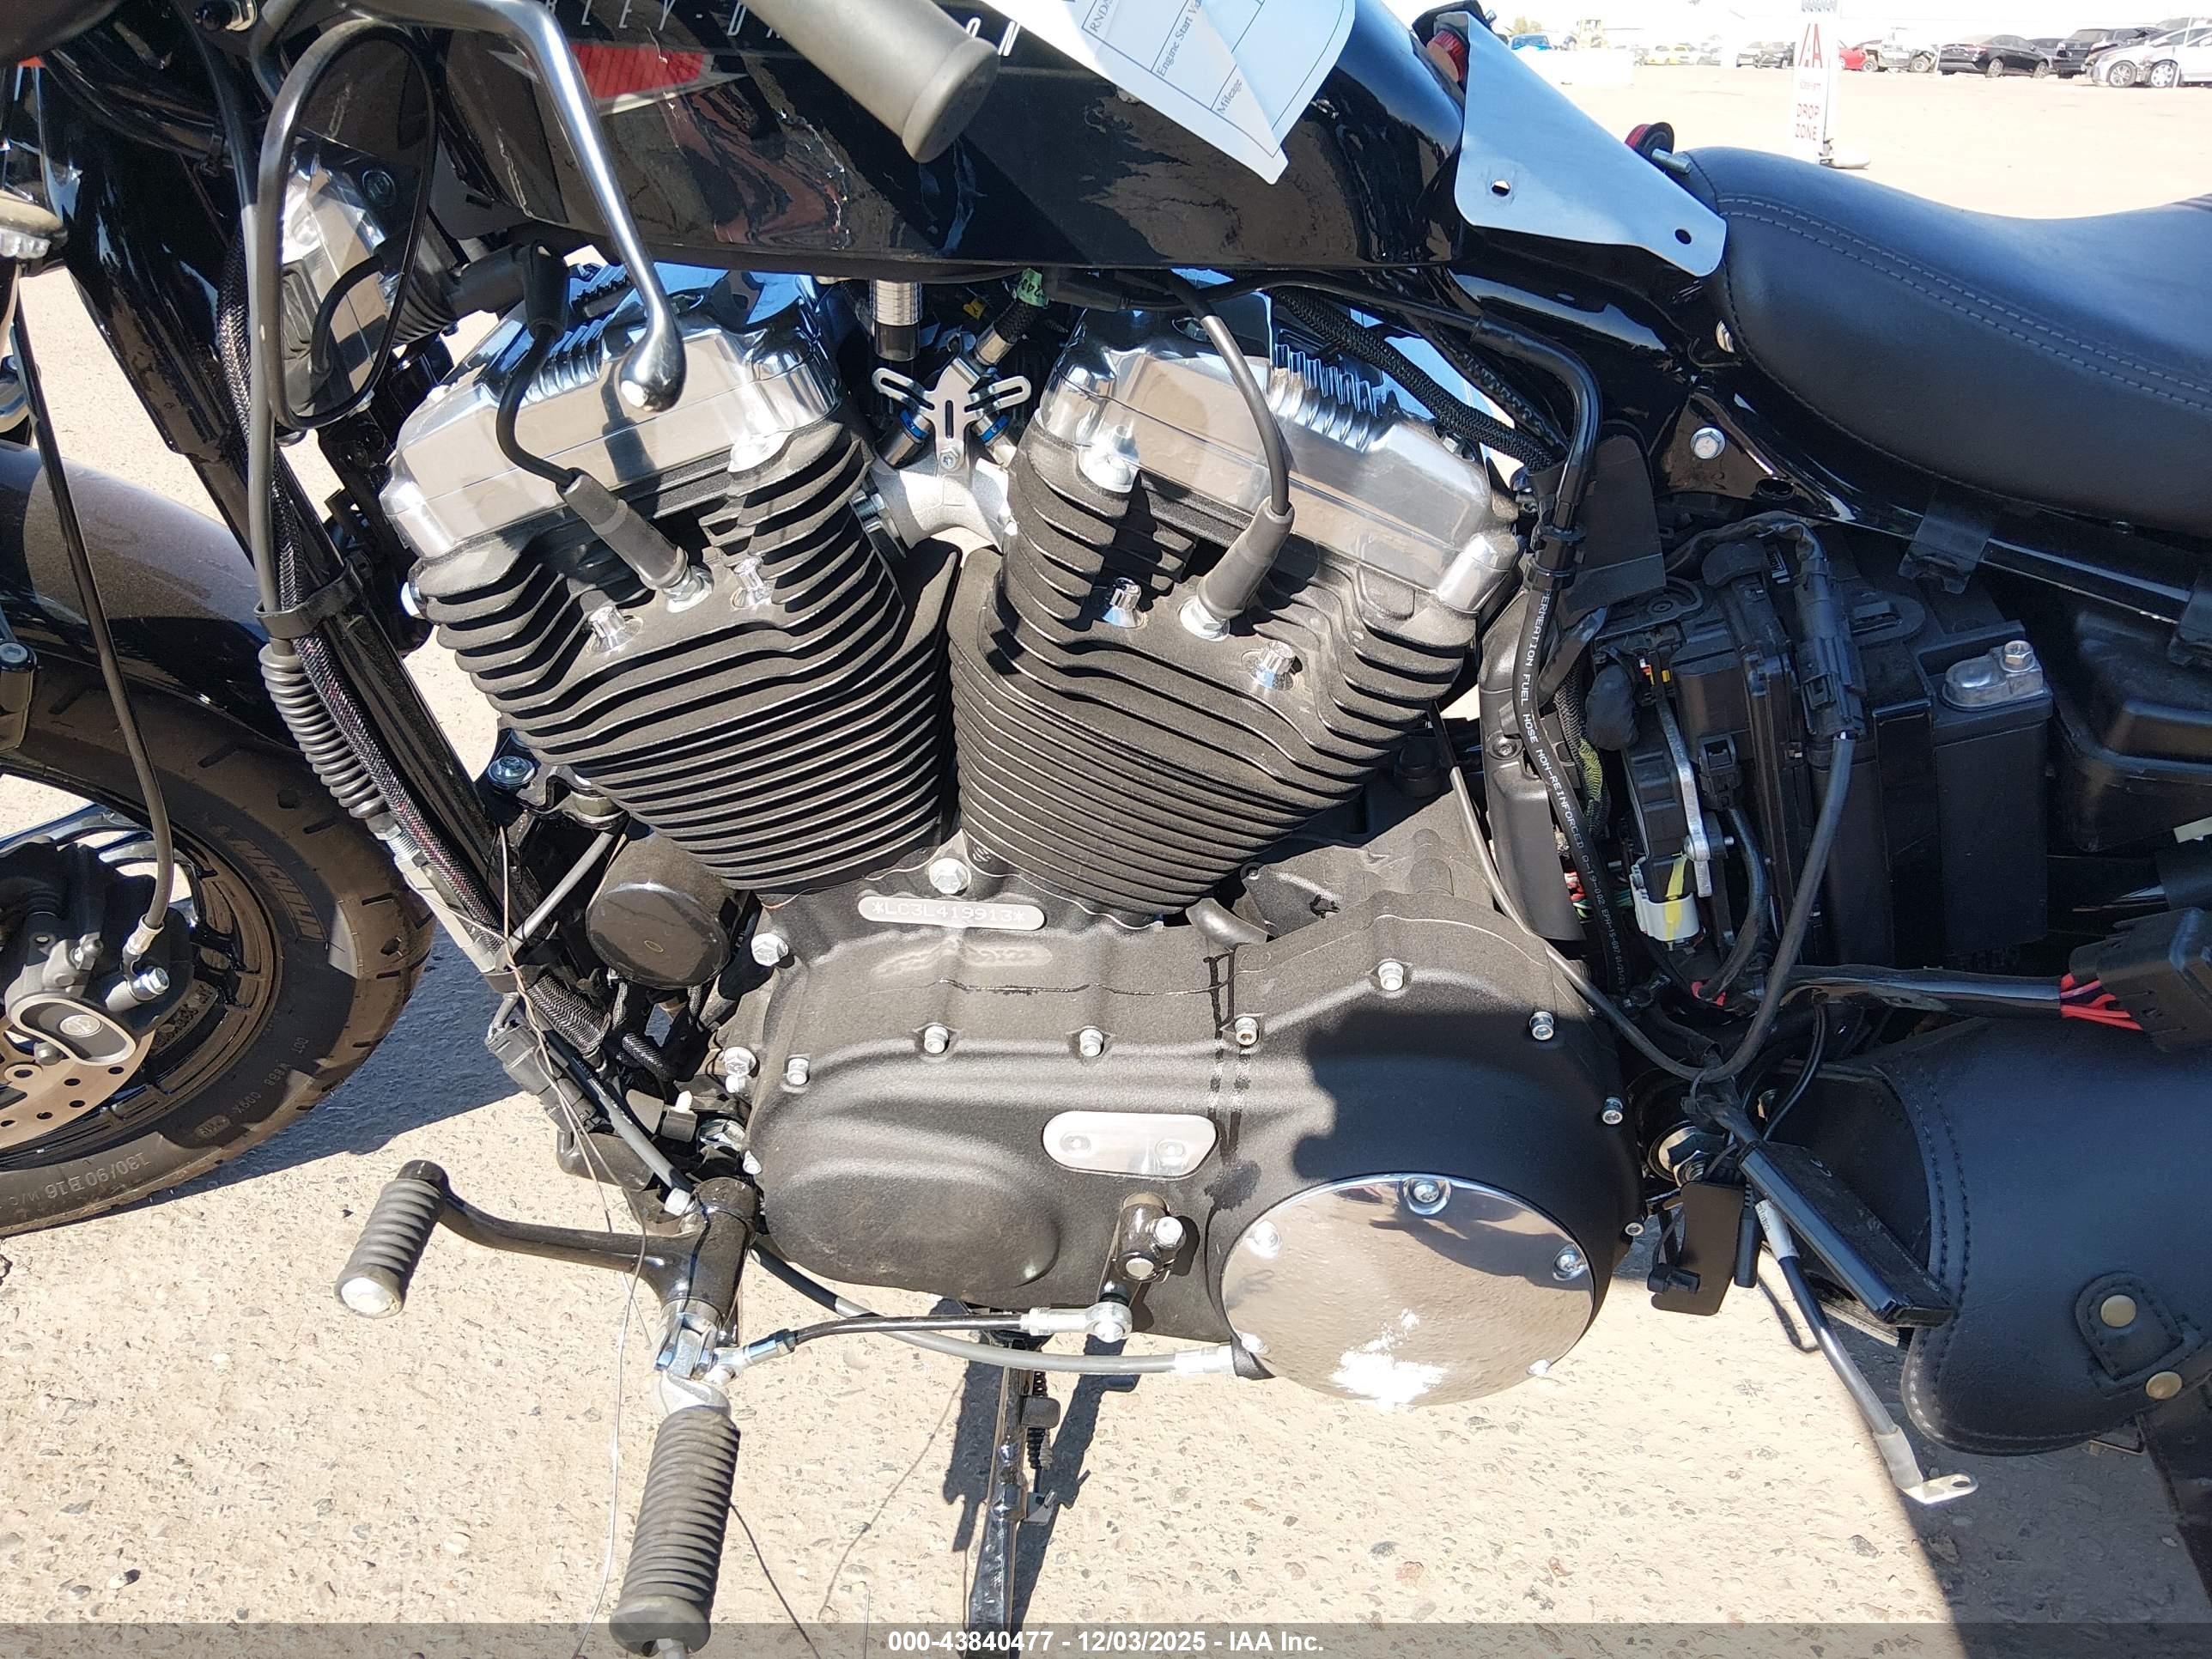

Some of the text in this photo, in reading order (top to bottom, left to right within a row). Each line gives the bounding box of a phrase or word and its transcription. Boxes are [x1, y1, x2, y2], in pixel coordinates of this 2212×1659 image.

[1157, 41, 1180, 77] Engine
[1217, 79, 1243, 114] Mileage
[1796, 103, 1820, 119] DROP
[1795, 124, 1817, 141] ZONE
[1525, 588, 1552, 666] PERMEATION
[1521, 673, 1530, 707] FUEL
[1522, 714, 1539, 744] HOSE
[1535, 748, 1585, 849] NON-REINFORCED
